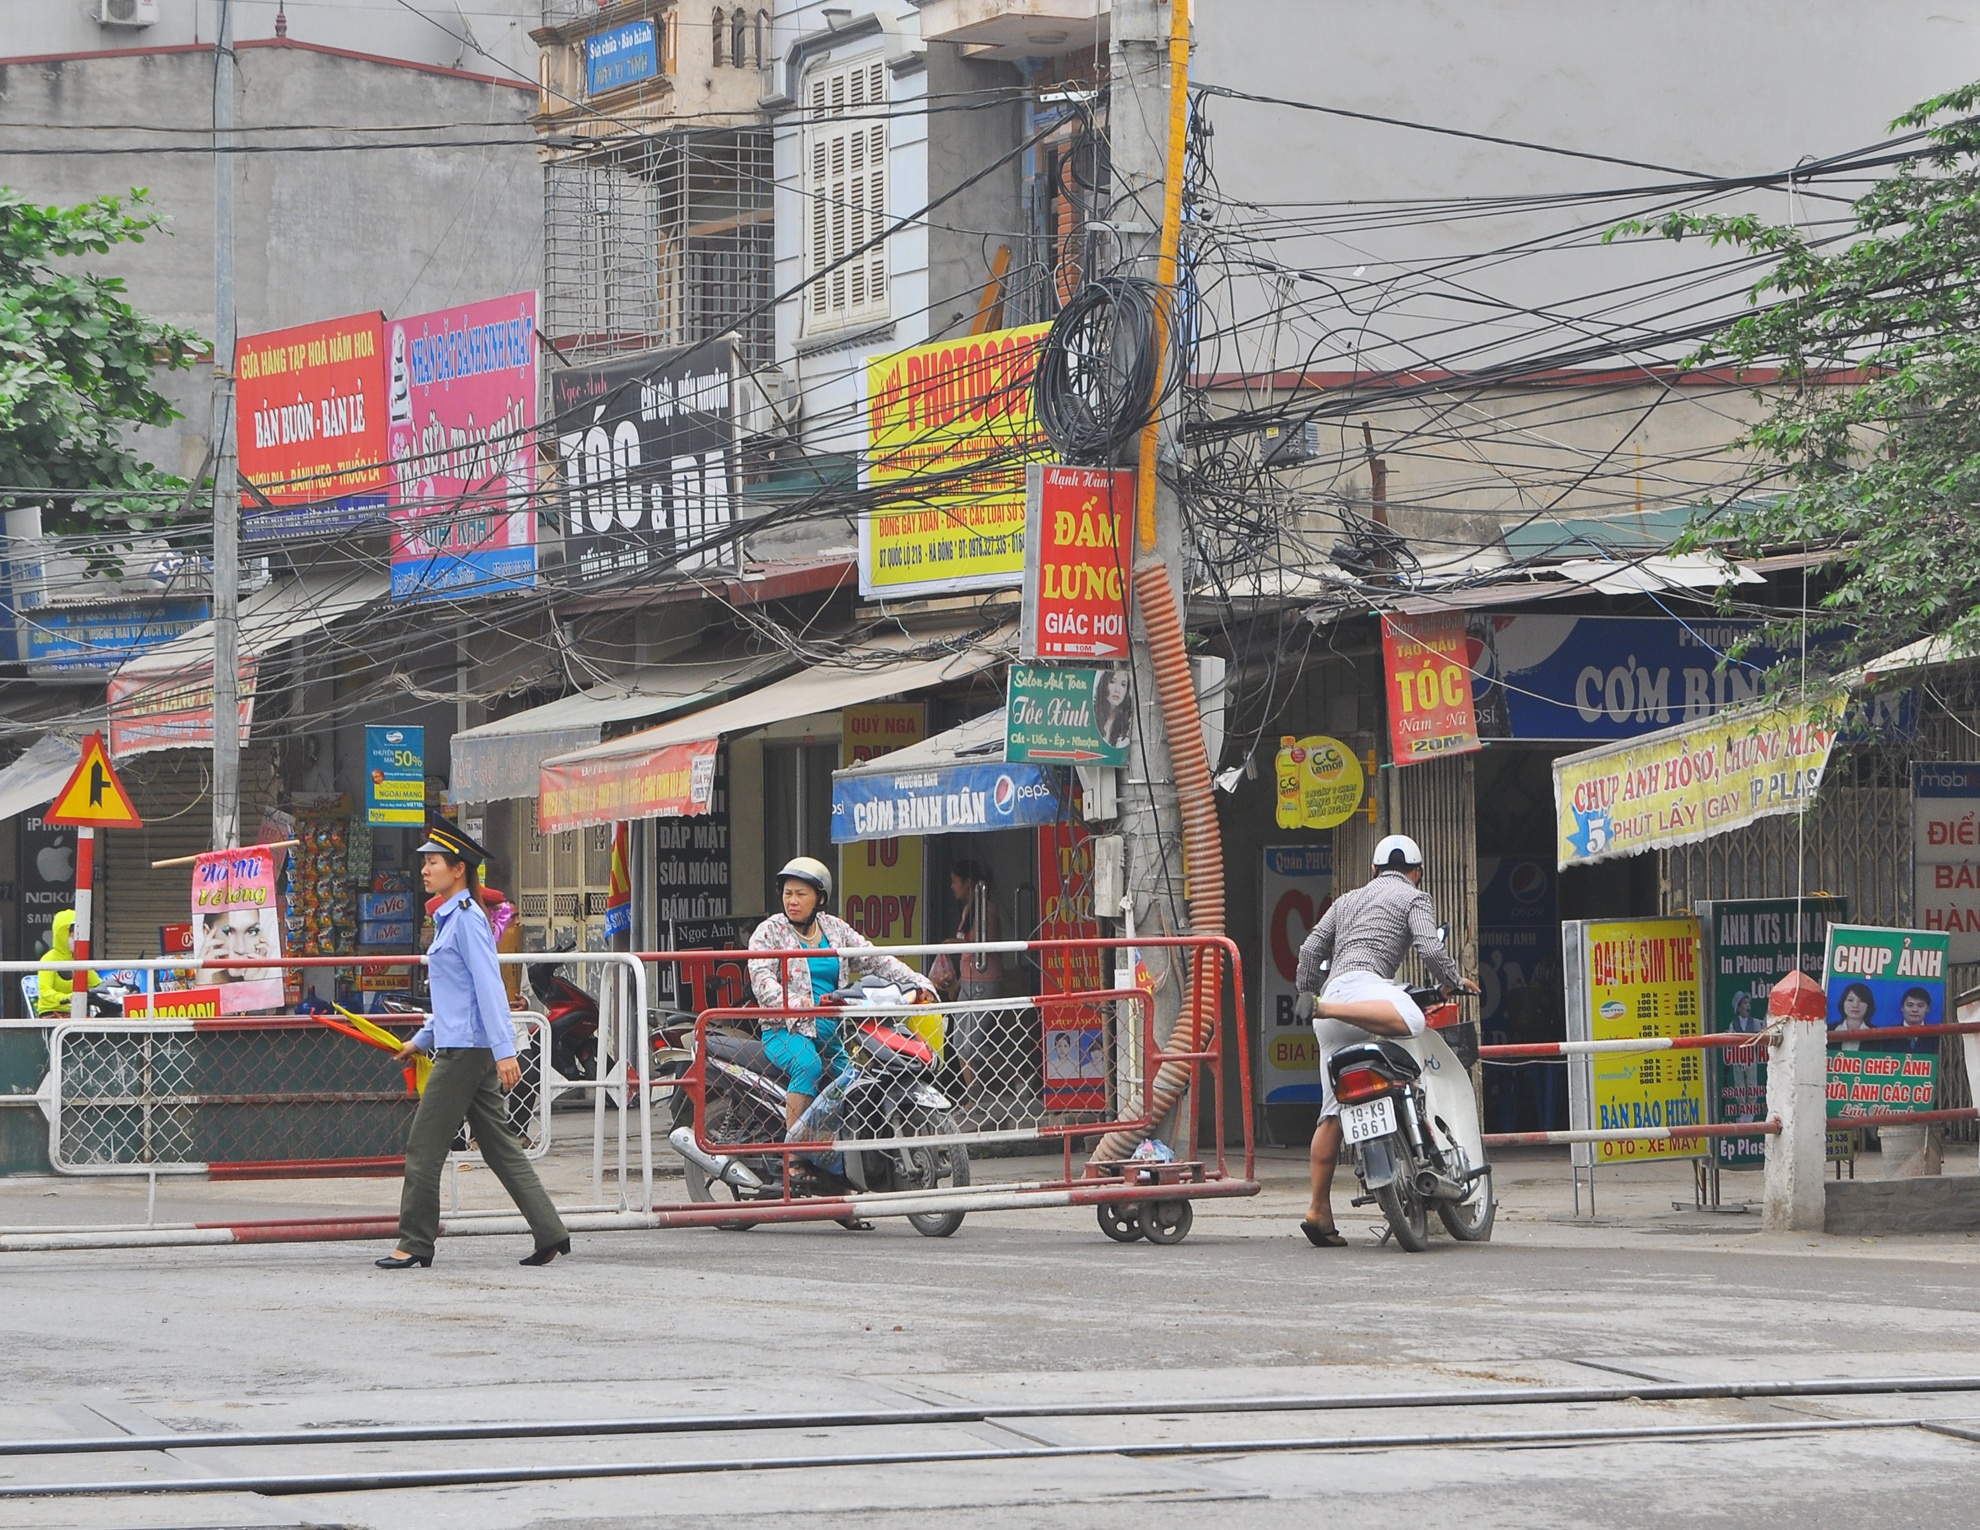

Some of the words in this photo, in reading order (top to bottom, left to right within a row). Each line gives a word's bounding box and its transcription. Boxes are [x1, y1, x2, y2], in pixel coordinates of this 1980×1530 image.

[634, 26, 652, 46] hành
[241, 344, 260, 380] CỬA
[261, 345, 286, 376] HÀNG
[288, 344, 306, 375] TẠP
[308, 334, 328, 367] HOÁ
[330, 332, 352, 363] NĂM
[355, 330, 374, 358] HOA
[556, 379, 582, 410] Ngọc
[583, 371, 608, 398] Anh
[640, 379, 656, 422] CẮT
[886, 361, 902, 415] NGA
[254, 398, 280, 449] BÁN
[281, 391, 314, 444] BUÔN
[322, 386, 348, 438] BÁN
[350, 377, 366, 433] LẺ
[560, 405, 643, 534] TÓC
[651, 483, 667, 533] &
[672, 450, 735, 571] DA
[1046, 469, 1079, 490] Mạnh
[1082, 471, 1114, 489] Hùng
[902, 511, 916, 534] GÁY
[970, 501, 985, 526] CÁC
[988, 504, 1004, 528] LOẠI
[1054, 496, 1122, 548] ĐẤM
[887, 539, 902, 570] QUỐC
[904, 541, 912, 570] LỘ
[928, 538, 937, 563] HÀ
[1043, 562, 1127, 601] LƯNG
[1045, 608, 1088, 635] GIÁC
[1094, 614, 1123, 636] HƠI
[1396, 643, 1422, 660] TẠO
[1395, 660, 1464, 712] TÓC
[1575, 654, 1670, 724] CƠM
[851, 714, 880, 734] QUÝ
[885, 718, 916, 734] NGA
[1012, 696, 1043, 725] Tóc
[1047, 698, 1090, 728] Xinh
[1399, 718, 1432, 734] Nam
[1445, 712, 1468, 728] Nữ
[1010, 732, 1026, 744] Cắt
[1031, 733, 1048, 745] Uốn
[1054, 732, 1066, 748] Ép
[1414, 736, 1464, 752] 20M
[394, 750, 422, 767] 50%
[1311, 760, 1344, 774] Lemon
[1574, 773, 1620, 816] CHỤP
[1622, 757, 1661, 800] ẢNH
[1664, 739, 1693, 791] HỒ
[854, 796, 894, 834] CƠM
[898, 792, 944, 831] BÌNH
[946, 786, 986, 826] DÂN
[660, 819, 690, 849] ĐẮP
[694, 821, 727, 854] MẶT
[1586, 818, 1606, 854] 5
[1612, 804, 1654, 842] PHÚT
[1658, 798, 1698, 832] LẤY
[232, 856, 262, 880] Mi
[660, 855, 686, 886] SỬA
[688, 856, 728, 886] MÓNG
[662, 892, 689, 921] BẤM
[692, 892, 706, 919] LỖ
[708, 898, 728, 918] TAI
[846, 895, 917, 939] COPY
[678, 926, 707, 943] Ngọc
[710, 922, 734, 938] Anh
[1720, 906, 1750, 946] ẢNH
[1754, 913, 1780, 944] KTS
[1784, 912, 1811, 944] LAN
[1594, 941, 1618, 996] ĐẠI
[1620, 933, 1636, 985] LÝ
[1640, 937, 1666, 984] SIM
[1669, 924, 1694, 982] THẺ
[1721, 956, 1732, 974] In
[1736, 954, 1774, 975] Phóng
[1776, 950, 1798, 972] Ảnh
[1834, 944, 1892, 980] CHỤP
[1896, 937, 1943, 977] ẢNH
[1276, 1042, 1306, 1062] BIA
[1864, 1056, 1900, 1076] GHÉP
[1902, 1054, 1932, 1076] ẢNH
[1850, 1077, 1880, 1102] ẢNH
[1882, 1081, 1910, 1103] CÁC
[1912, 1082, 1934, 1104] CỠ
[1350, 1102, 1386, 1124] 19-K9
[1600, 1096, 1630, 1130] BÁN
[1632, 1090, 1662, 1128] BẢO
[1665, 1084, 1700, 1126] HIỂM
[1725, 1104, 1736, 1116] IN
[1352, 1117, 1388, 1140] 6861
[1648, 1139, 1664, 1154] XE
[1720, 1136, 1736, 1161] Ép
